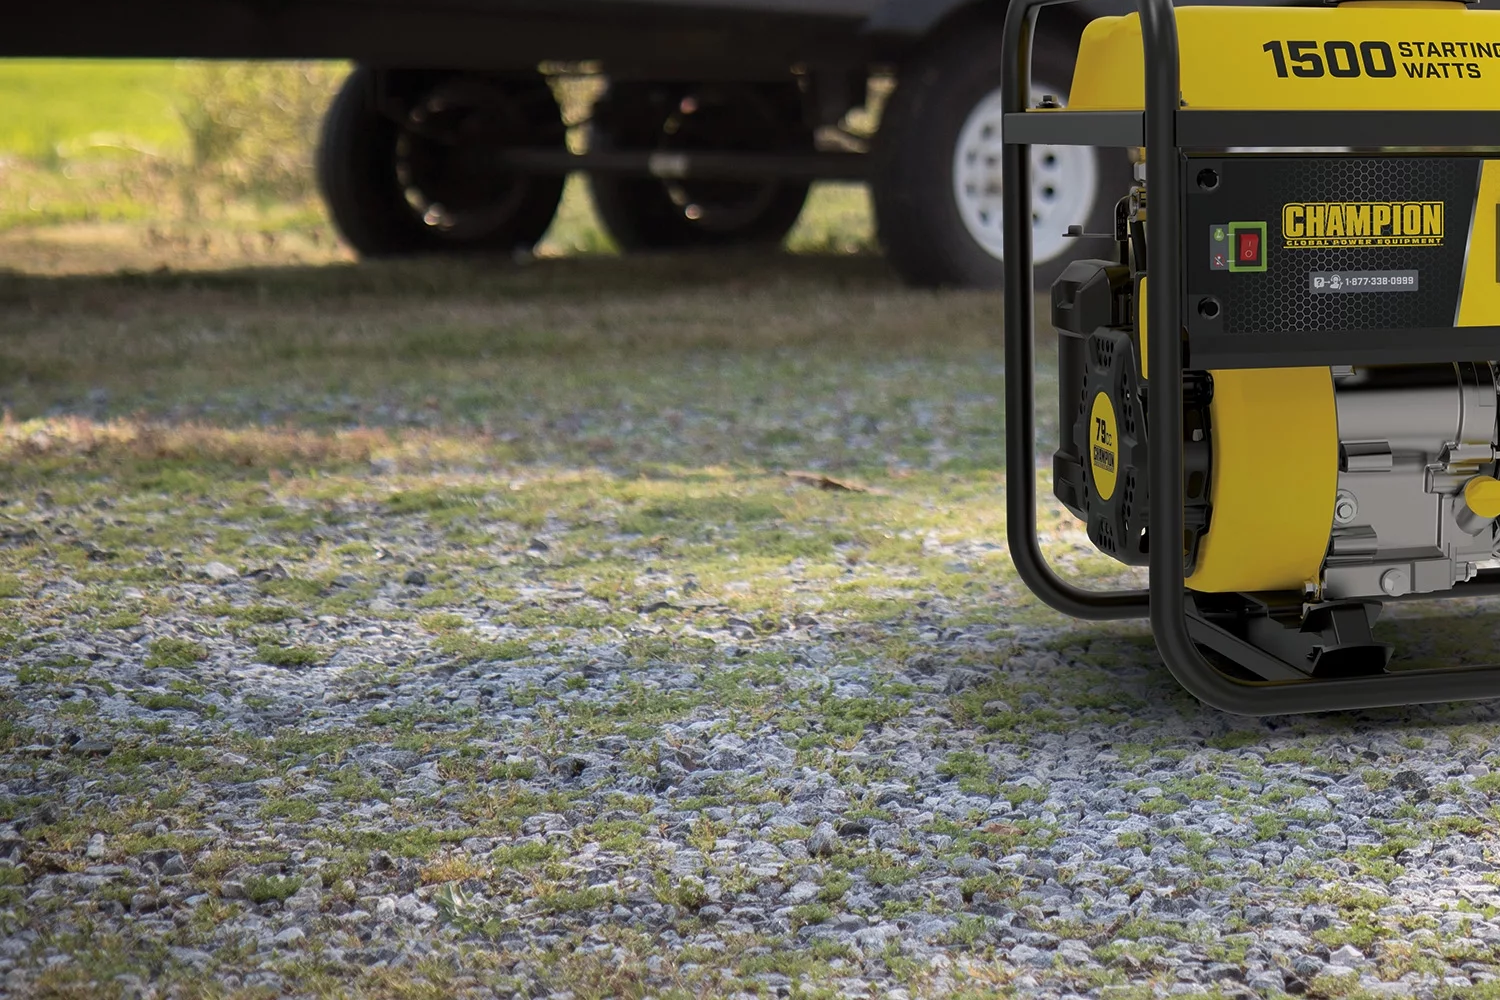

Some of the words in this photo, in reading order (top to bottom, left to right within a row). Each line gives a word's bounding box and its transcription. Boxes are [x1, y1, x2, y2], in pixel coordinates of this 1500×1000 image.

[1262, 40, 1397, 78] 1500
[1402, 62, 1482, 79] WATTS
[1284, 203, 1442, 238] CHAMPION
